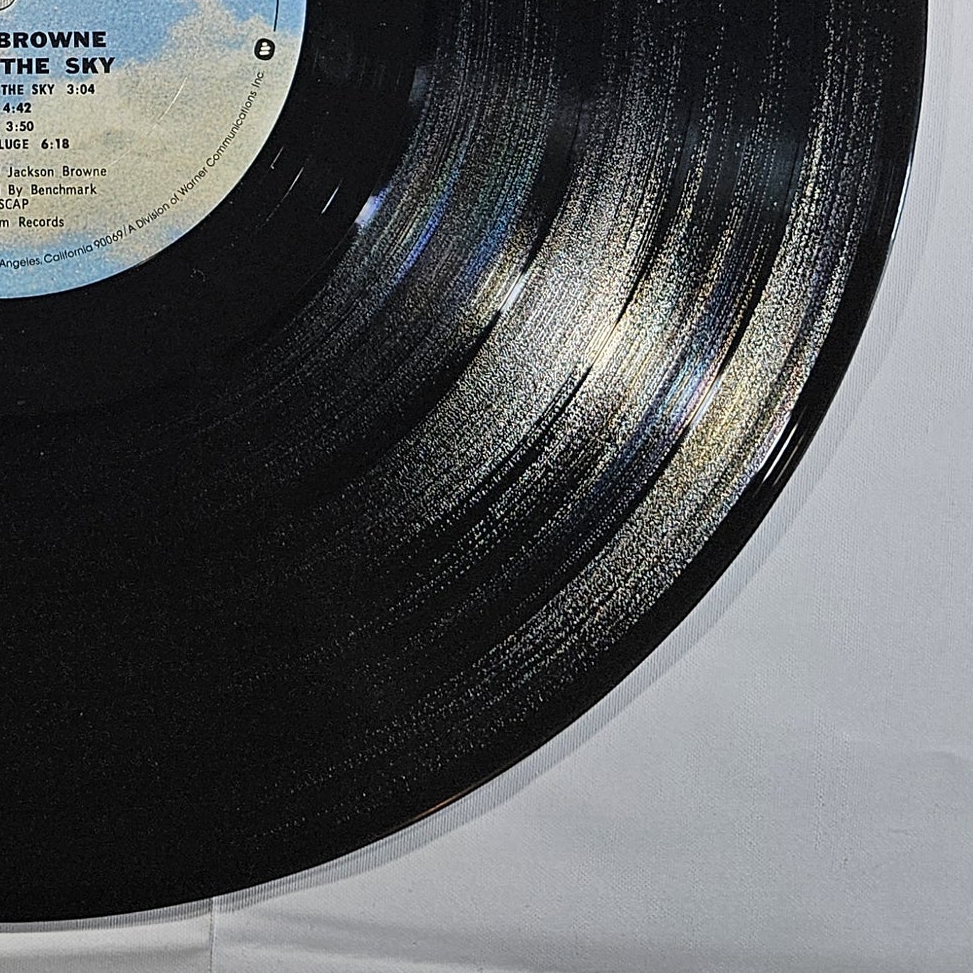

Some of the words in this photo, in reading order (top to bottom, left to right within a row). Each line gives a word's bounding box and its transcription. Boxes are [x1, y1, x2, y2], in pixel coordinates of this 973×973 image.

[0, 58, 50, 75] THE
[65, 57, 116, 74] SKY
[1, 84, 24, 95] THE
[31, 84, 55, 95] SKY
[66, 83, 96, 95] 3:04
[2, 102, 33, 114] 4:42
[5, 121, 35, 132] 3:50
[40, 138, 70, 150] 6:18
[7, 165, 54, 177] Jackson
[62, 165, 107, 177] Browne
[0, 257, 43, 270] Angeles,
[43, 245, 94, 264] California
[135, 203, 170, 228] Division
[170, 194, 181, 206] of
[178, 166, 209, 197] Warner
[205, 90, 257, 168] Communications
[8, 184, 23, 197] By
[31, 183, 97, 195] Benchmark
[18, 215, 65, 228] Records
